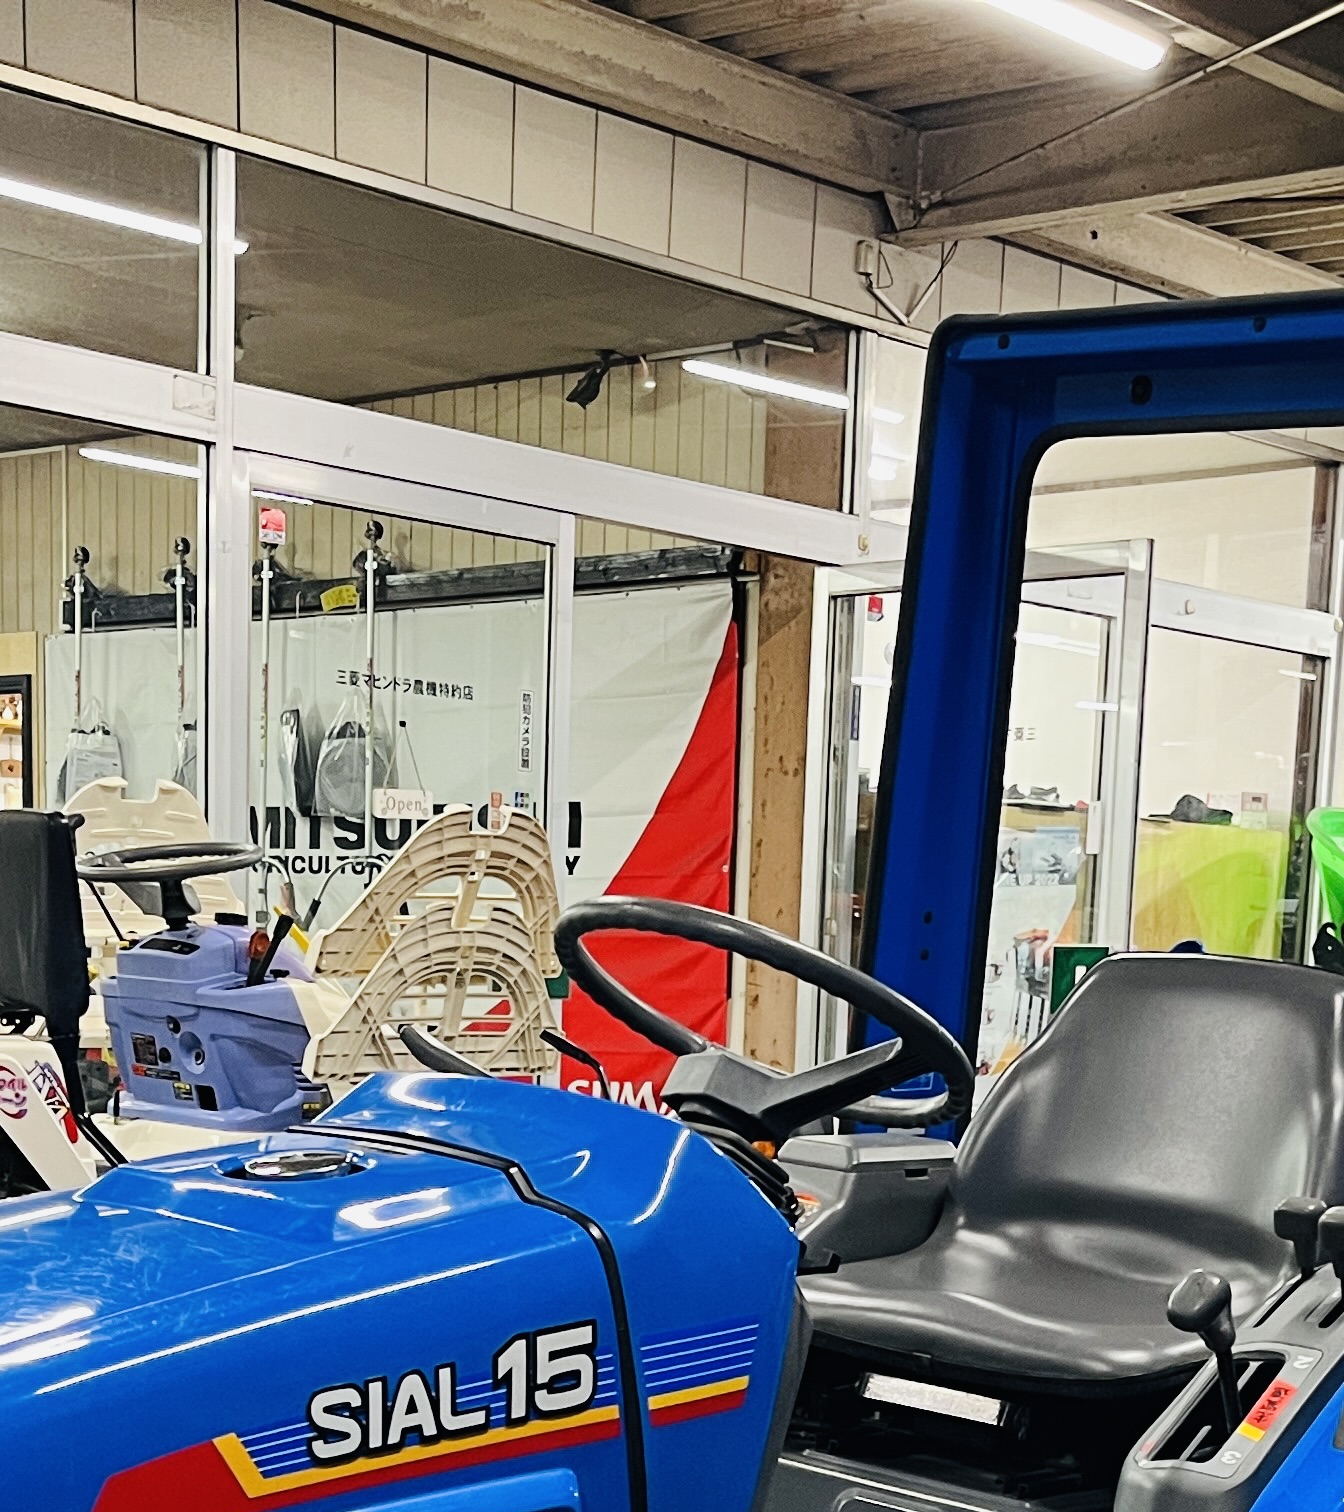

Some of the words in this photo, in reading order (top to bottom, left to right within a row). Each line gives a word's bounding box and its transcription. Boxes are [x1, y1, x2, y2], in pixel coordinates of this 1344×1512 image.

[386, 796, 422, 813] Open
[1293, 1355, 1314, 1369] 2
[310, 1366, 487, 1459] SIAL
[497, 1324, 594, 1420] 15
[1221, 1450, 1242, 1465] 3
